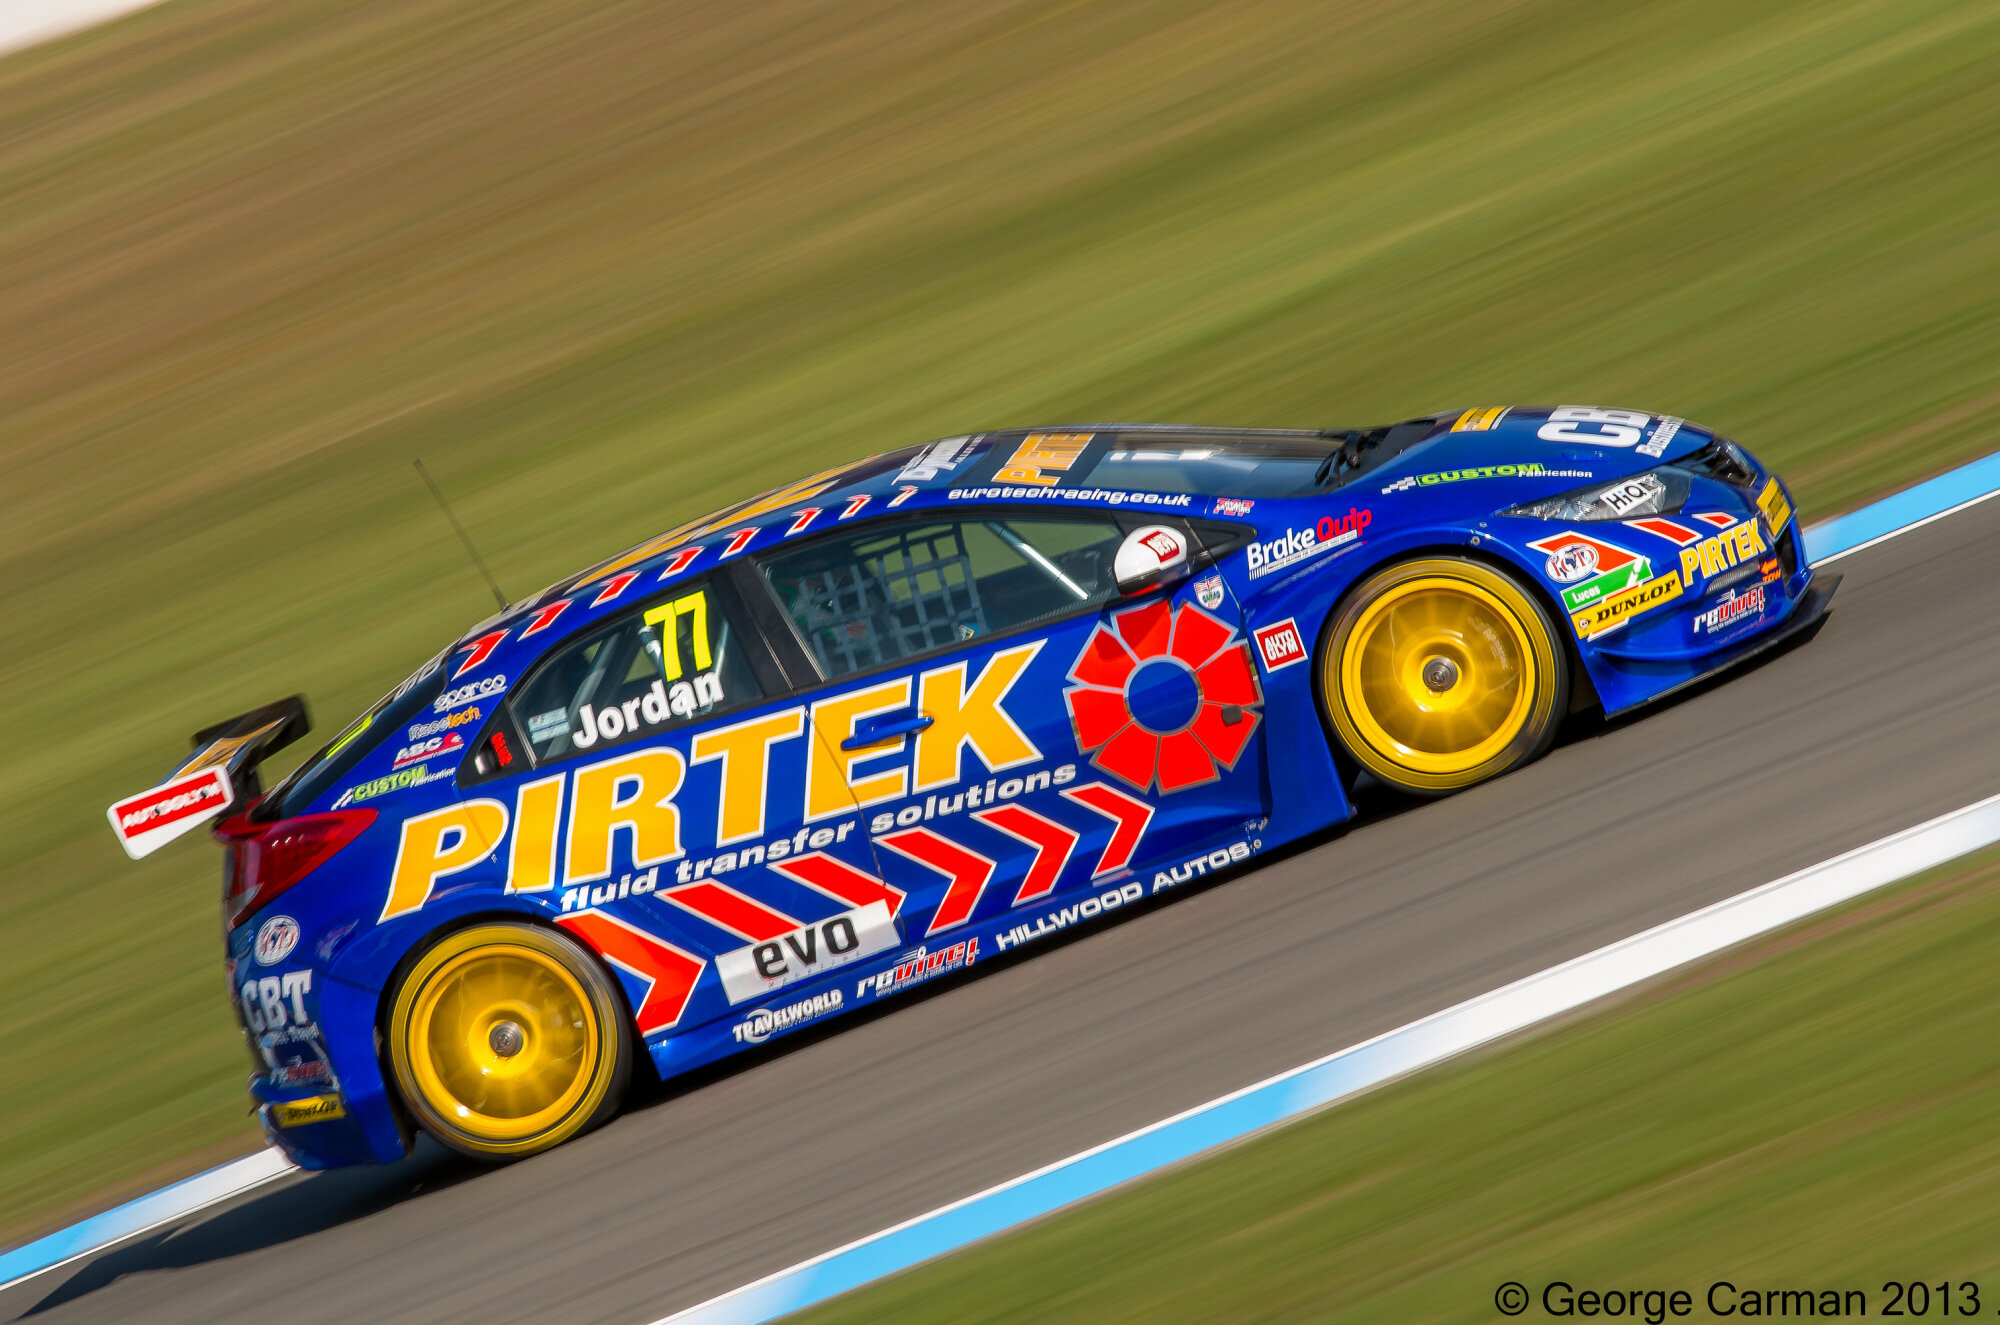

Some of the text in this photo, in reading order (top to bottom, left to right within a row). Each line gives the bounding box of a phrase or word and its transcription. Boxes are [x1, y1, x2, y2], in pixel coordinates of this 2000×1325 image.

[948, 486, 1192, 507] eurotechracing.co.uk
[1421, 463, 1592, 485] CUSTOM Fabrication
[1606, 483, 1648, 511] HiQ
[1679, 517, 1767, 588] PIRTEK
[1572, 585, 1601, 604] Lucas
[1596, 579, 1676, 624] DUNLOP
[642, 591, 713, 681] 77
[433, 674, 507, 713] sparco
[572, 672, 724, 748] Jordan
[395, 736, 444, 763] ABC
[353, 765, 428, 801] CUSTOM
[377, 637, 1048, 925] PIRTEK
[560, 764, 1076, 913] fluid transfer solutions
[996, 841, 1251, 951] HILLWOOD AUTOS
[752, 917, 860, 979] evo
[241, 969, 312, 1034] CBT
[732, 988, 843, 1042] TRAVELWORLD
